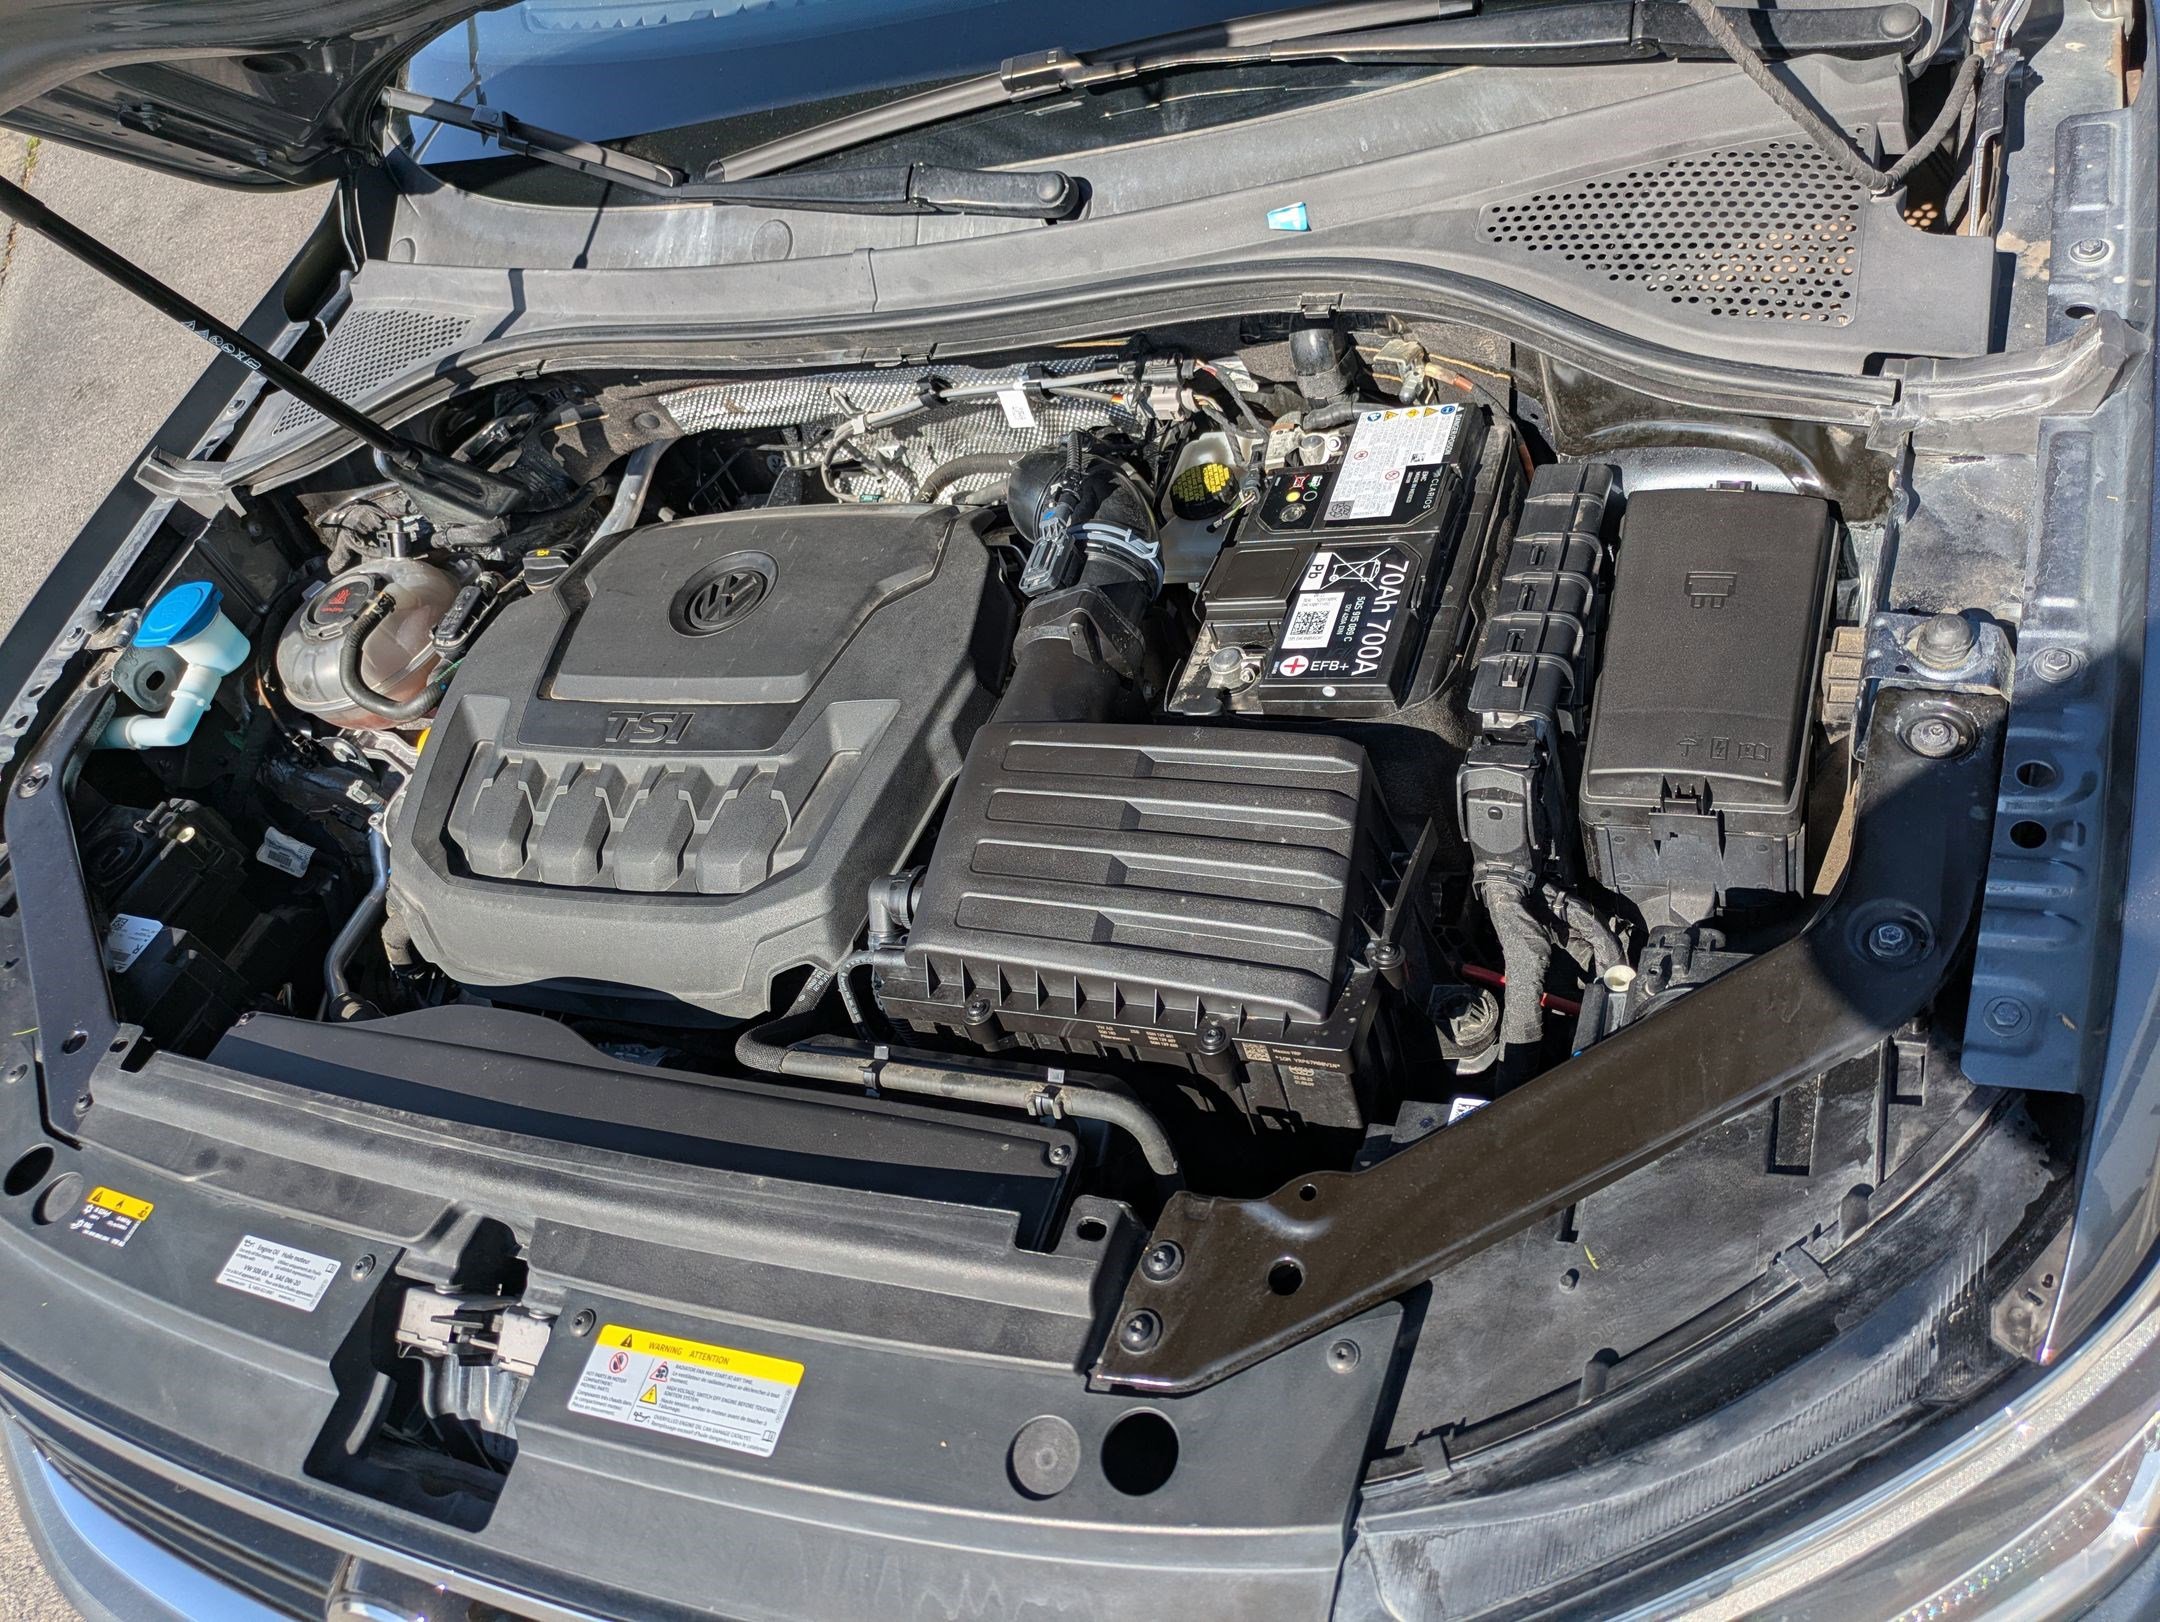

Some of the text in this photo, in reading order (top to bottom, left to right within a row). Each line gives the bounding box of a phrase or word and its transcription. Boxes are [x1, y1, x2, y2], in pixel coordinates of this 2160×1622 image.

[1422, 478, 1439, 509] CLARIOS
[1308, 564, 1324, 579] Pb
[1344, 603, 1353, 612] 12V
[1350, 611, 1361, 623] 915
[1351, 560, 1410, 677] 70Ah 700A
[1336, 625, 1345, 635] DIN
[1346, 623, 1357, 636] 089
[1310, 660, 1349, 671] EFB+
[605, 710, 696, 744] TSI
[256, 1245, 311, 1266] Engine Oil Huile moteur
[243, 1264, 254, 1272] VW
[649, 1342, 730, 1365] WARNING ATTENTION
